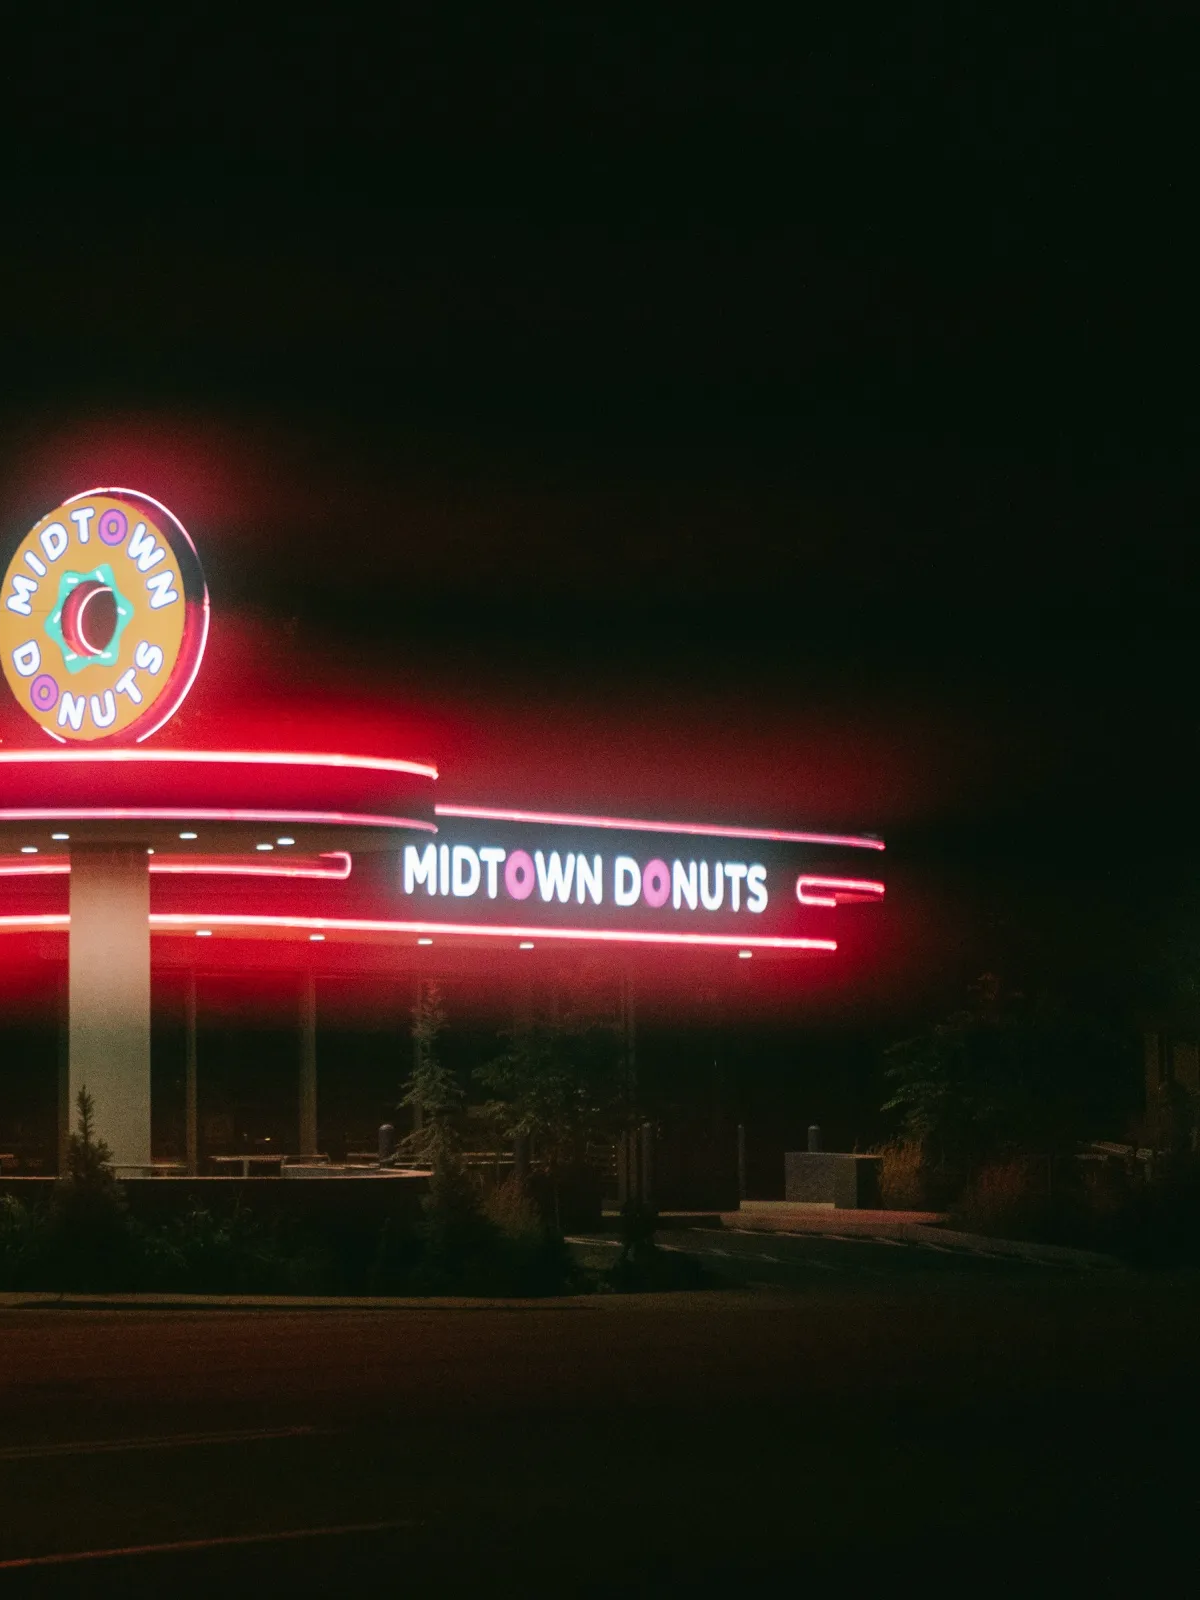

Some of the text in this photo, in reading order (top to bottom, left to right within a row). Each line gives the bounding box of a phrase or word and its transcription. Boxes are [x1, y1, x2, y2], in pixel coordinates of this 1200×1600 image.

[6, 507, 178, 615] MIDTOWN
[12, 639, 163, 730] DONUTS
[404, 843, 768, 913] MIDTOWN DONUTS
